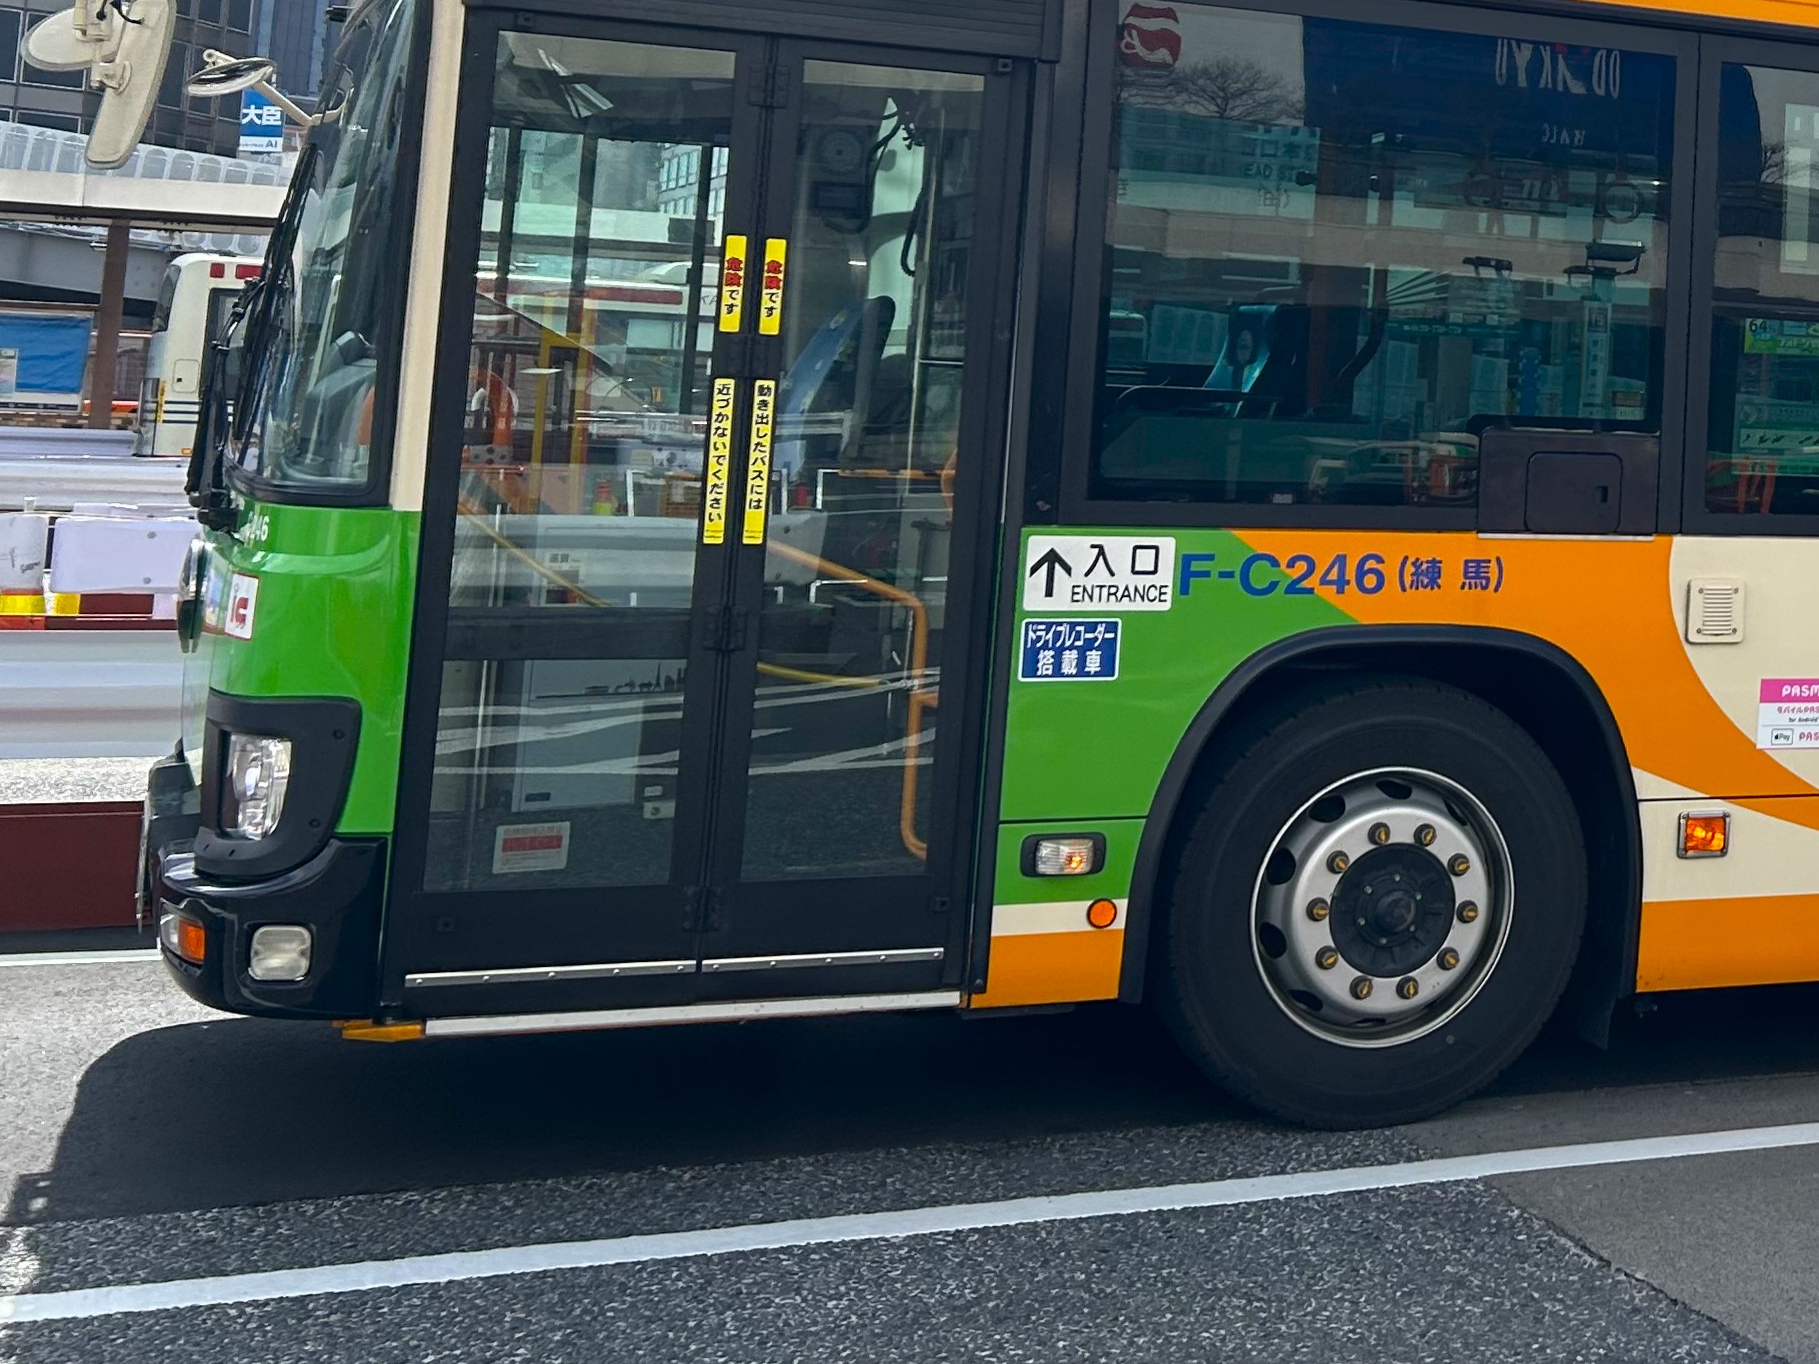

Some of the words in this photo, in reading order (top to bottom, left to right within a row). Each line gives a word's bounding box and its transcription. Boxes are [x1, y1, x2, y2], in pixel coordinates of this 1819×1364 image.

[241, 104, 283, 125] 大臣
[724, 256, 744, 315] 危険です
[764, 259, 784, 318] 危険です
[708, 383, 732, 523] 近づかないでください
[748, 384, 772, 510] 動き出したバスには
[1084, 543, 1160, 578] 入口
[1179, 553, 1386, 597] F-C246
[1398, 555, 1504, 593] (練馬)
[1070, 584, 1169, 605] ENTRANCE
[1026, 622, 1115, 648] ドライブレコーダー
[1036, 649, 1102, 676] 搭載車
